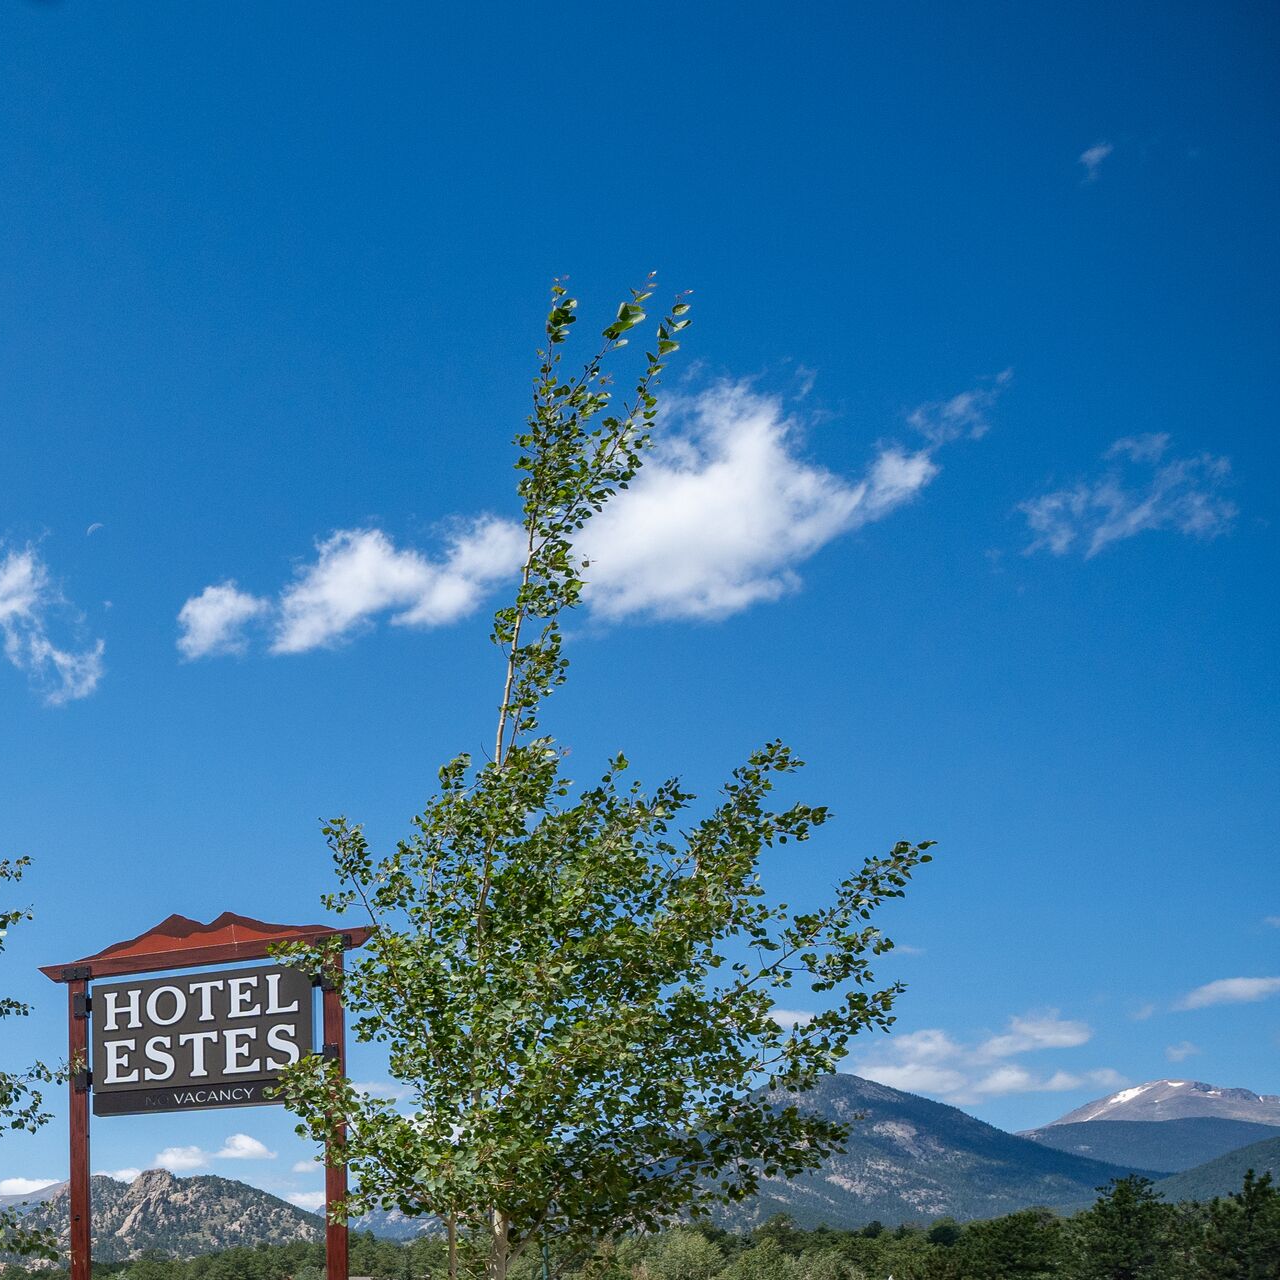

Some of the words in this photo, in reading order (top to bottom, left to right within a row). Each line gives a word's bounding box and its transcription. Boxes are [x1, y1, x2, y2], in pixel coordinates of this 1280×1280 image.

[103, 973, 299, 1032] HOTEL
[103, 1023, 301, 1085] ESTES
[173, 1087, 255, 1105] VACANCY
